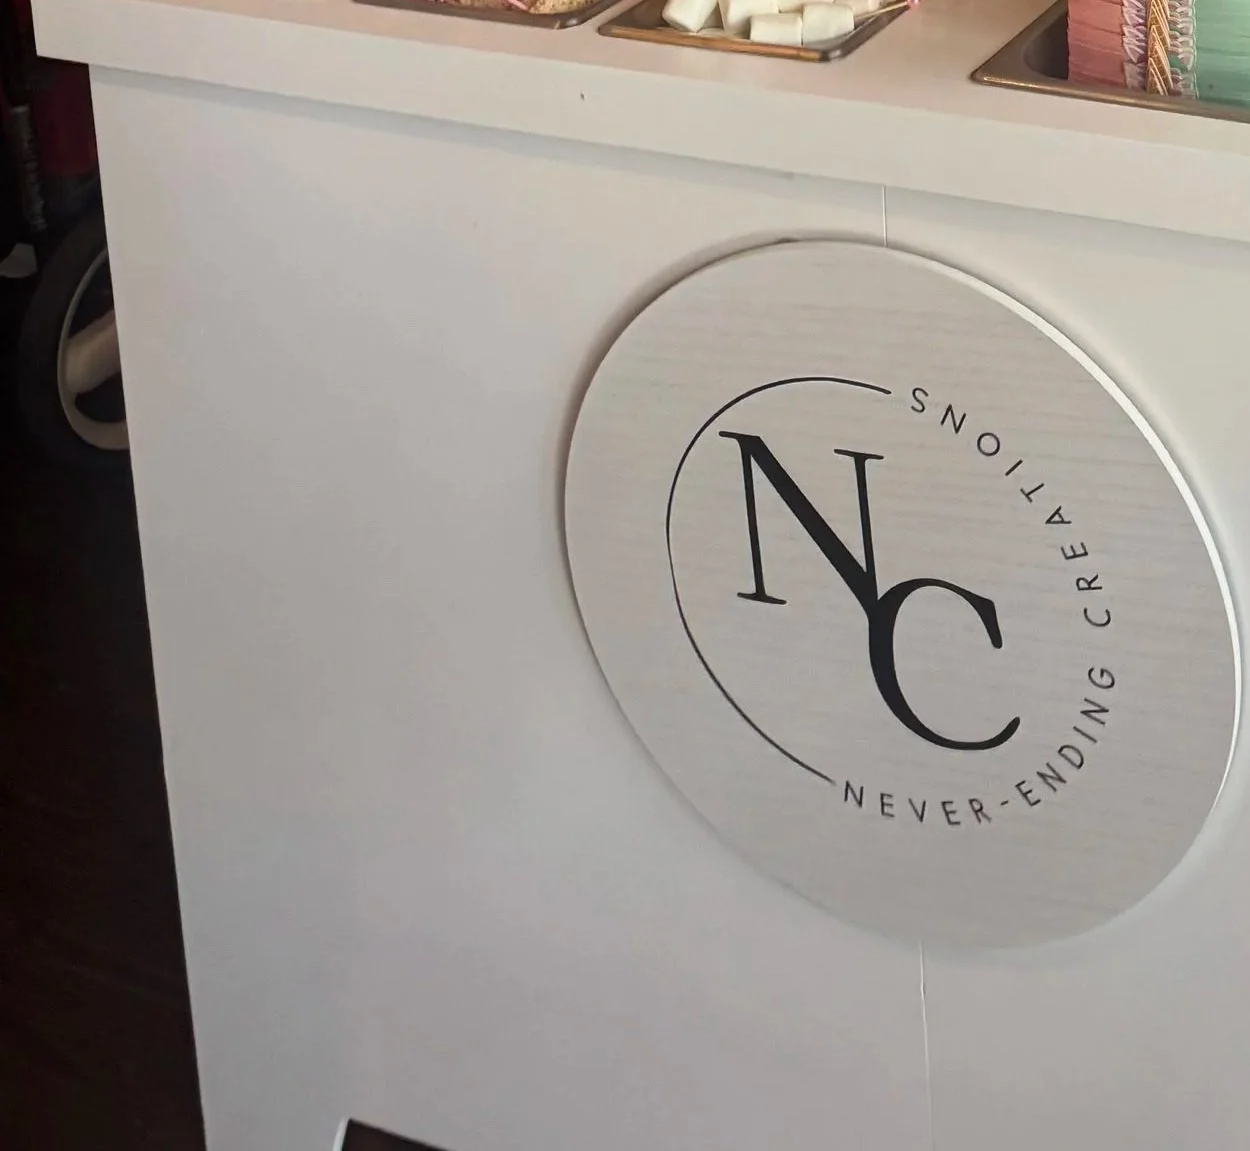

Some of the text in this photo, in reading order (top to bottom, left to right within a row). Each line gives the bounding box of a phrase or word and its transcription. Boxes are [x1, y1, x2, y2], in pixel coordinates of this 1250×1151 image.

[718, 429, 1021, 751] NC
[843, 386, 1116, 826] NEVER-ENDING CREATIONS
